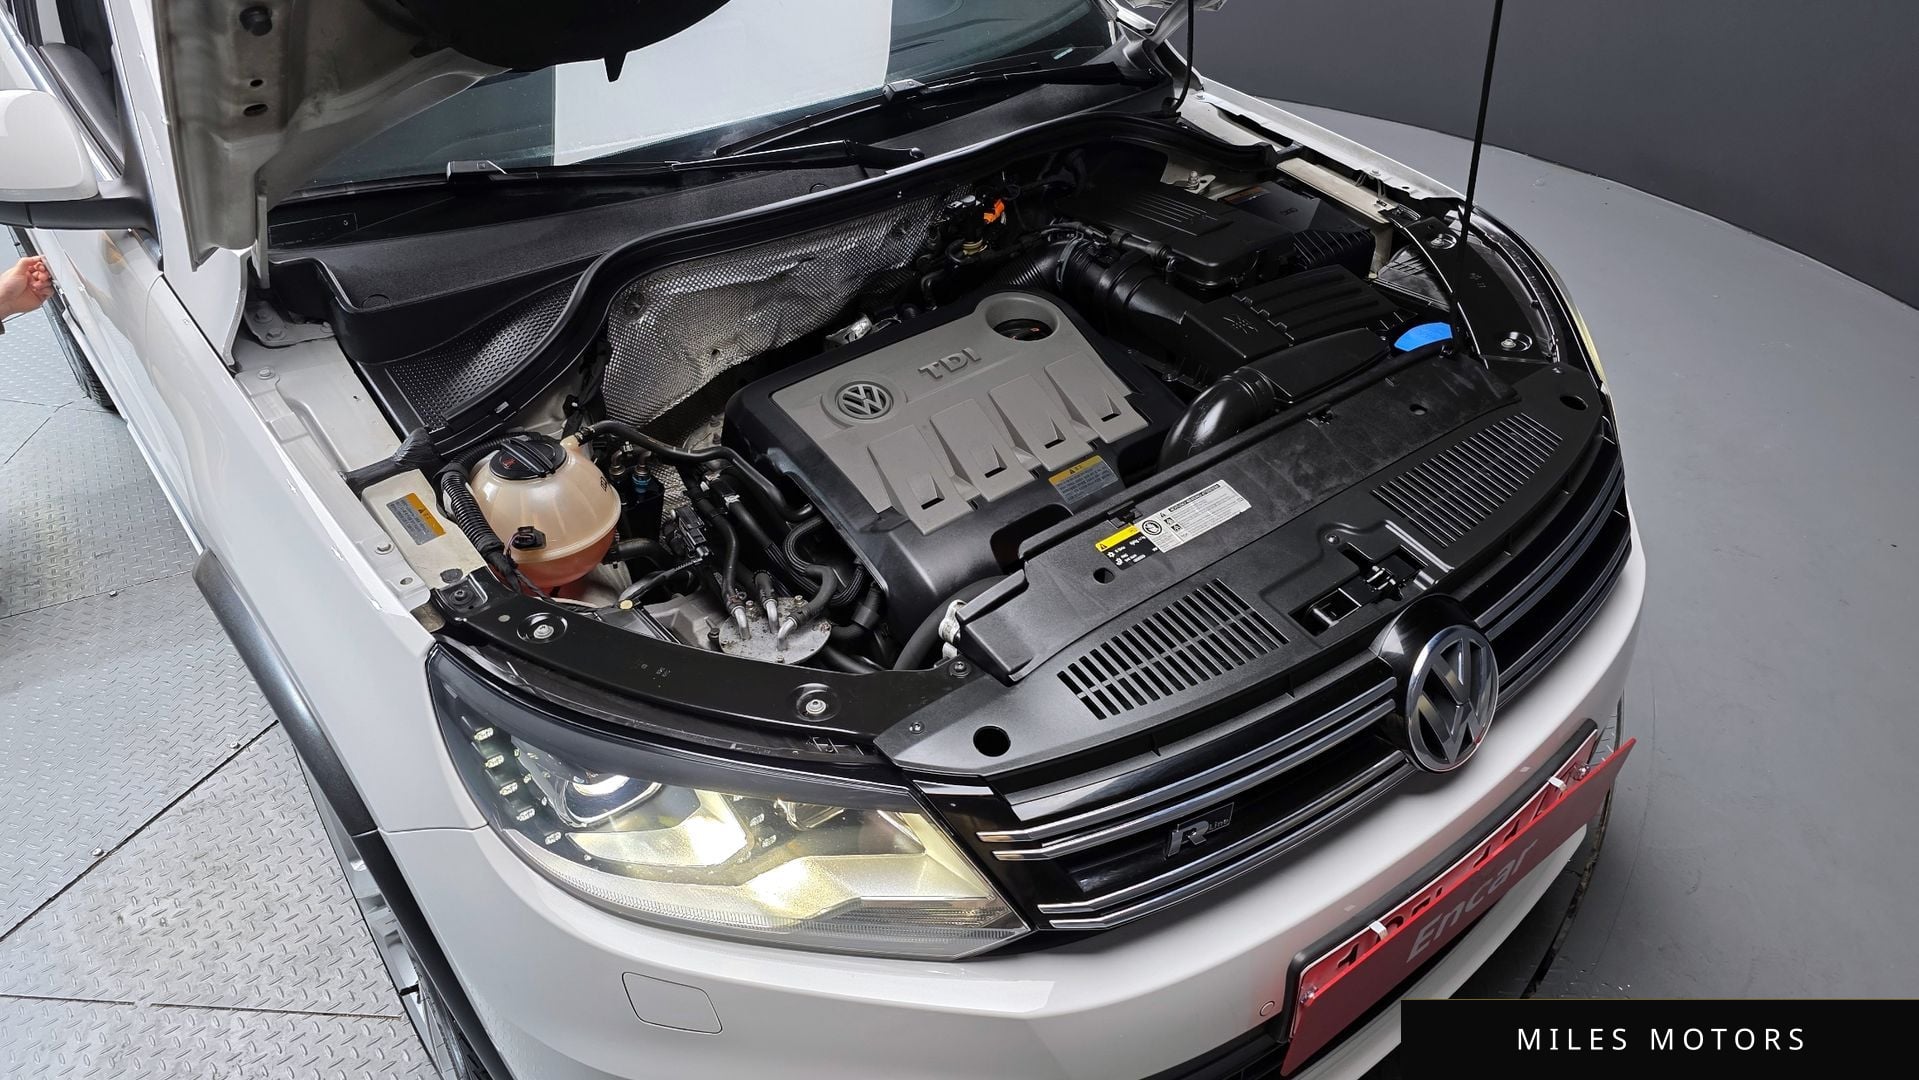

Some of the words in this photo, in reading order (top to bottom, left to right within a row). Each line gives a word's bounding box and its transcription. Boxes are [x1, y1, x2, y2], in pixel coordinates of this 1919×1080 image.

[918, 347, 981, 380] TDI
[1167, 821, 1209, 857] R
[1406, 839, 1538, 963] Encar
